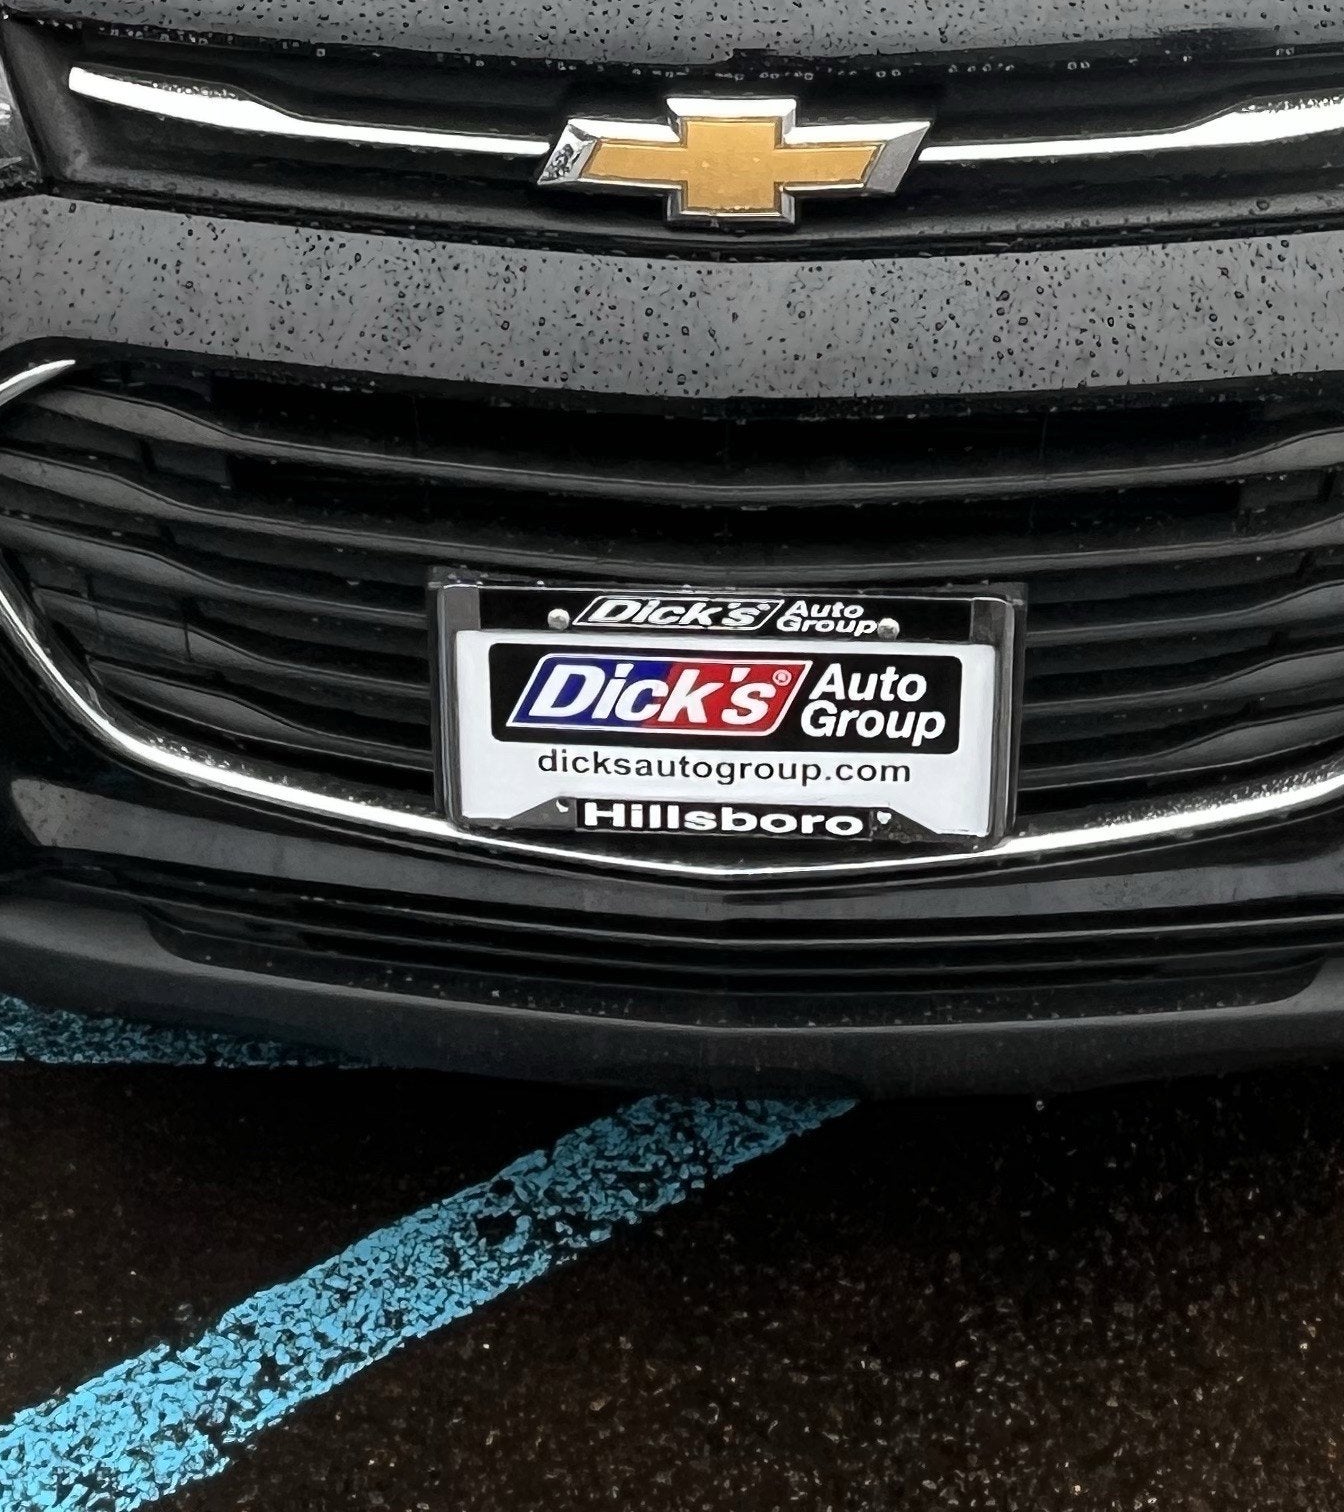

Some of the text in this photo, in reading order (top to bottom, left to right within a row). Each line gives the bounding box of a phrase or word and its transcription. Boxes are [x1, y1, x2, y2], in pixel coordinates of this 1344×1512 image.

[588, 599, 762, 626] Dick's
[776, 614, 879, 637] Group
[784, 600, 864, 619] Auto
[528, 662, 776, 725] Dick's
[808, 663, 928, 702] Auto
[800, 699, 946, 746] Group
[538, 748, 911, 785] dicksautogroup.com
[583, 801, 863, 836] Hillsboro
